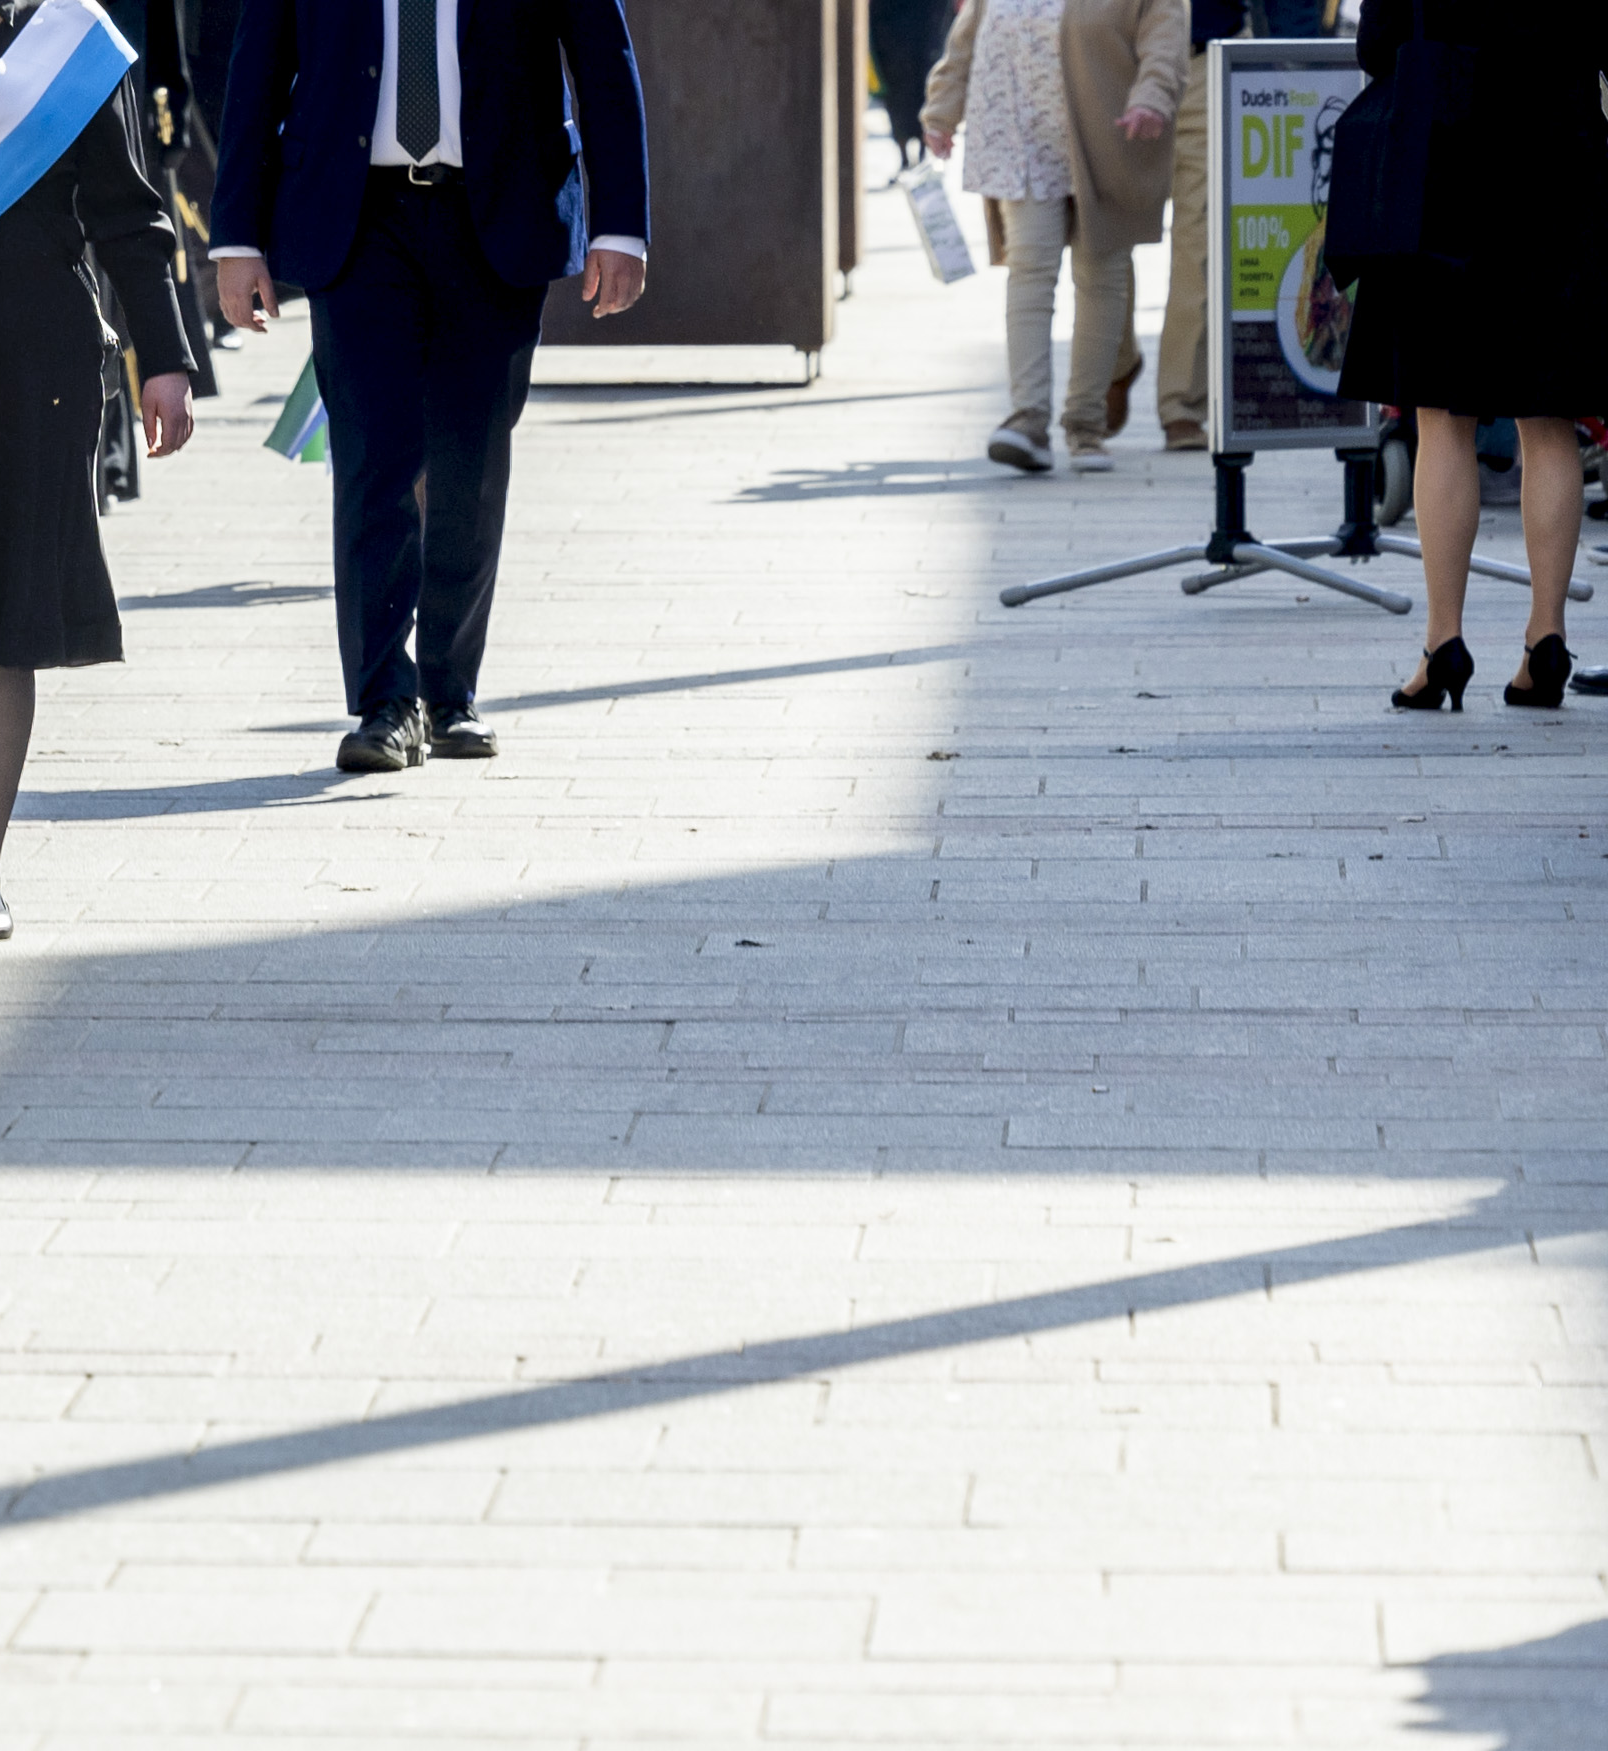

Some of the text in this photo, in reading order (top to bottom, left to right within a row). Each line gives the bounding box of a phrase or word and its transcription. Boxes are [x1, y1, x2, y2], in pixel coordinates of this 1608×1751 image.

[1241, 88, 1272, 108] Dude
[1241, 113, 1305, 179] DIF
[1237, 214, 1290, 251] 100%
